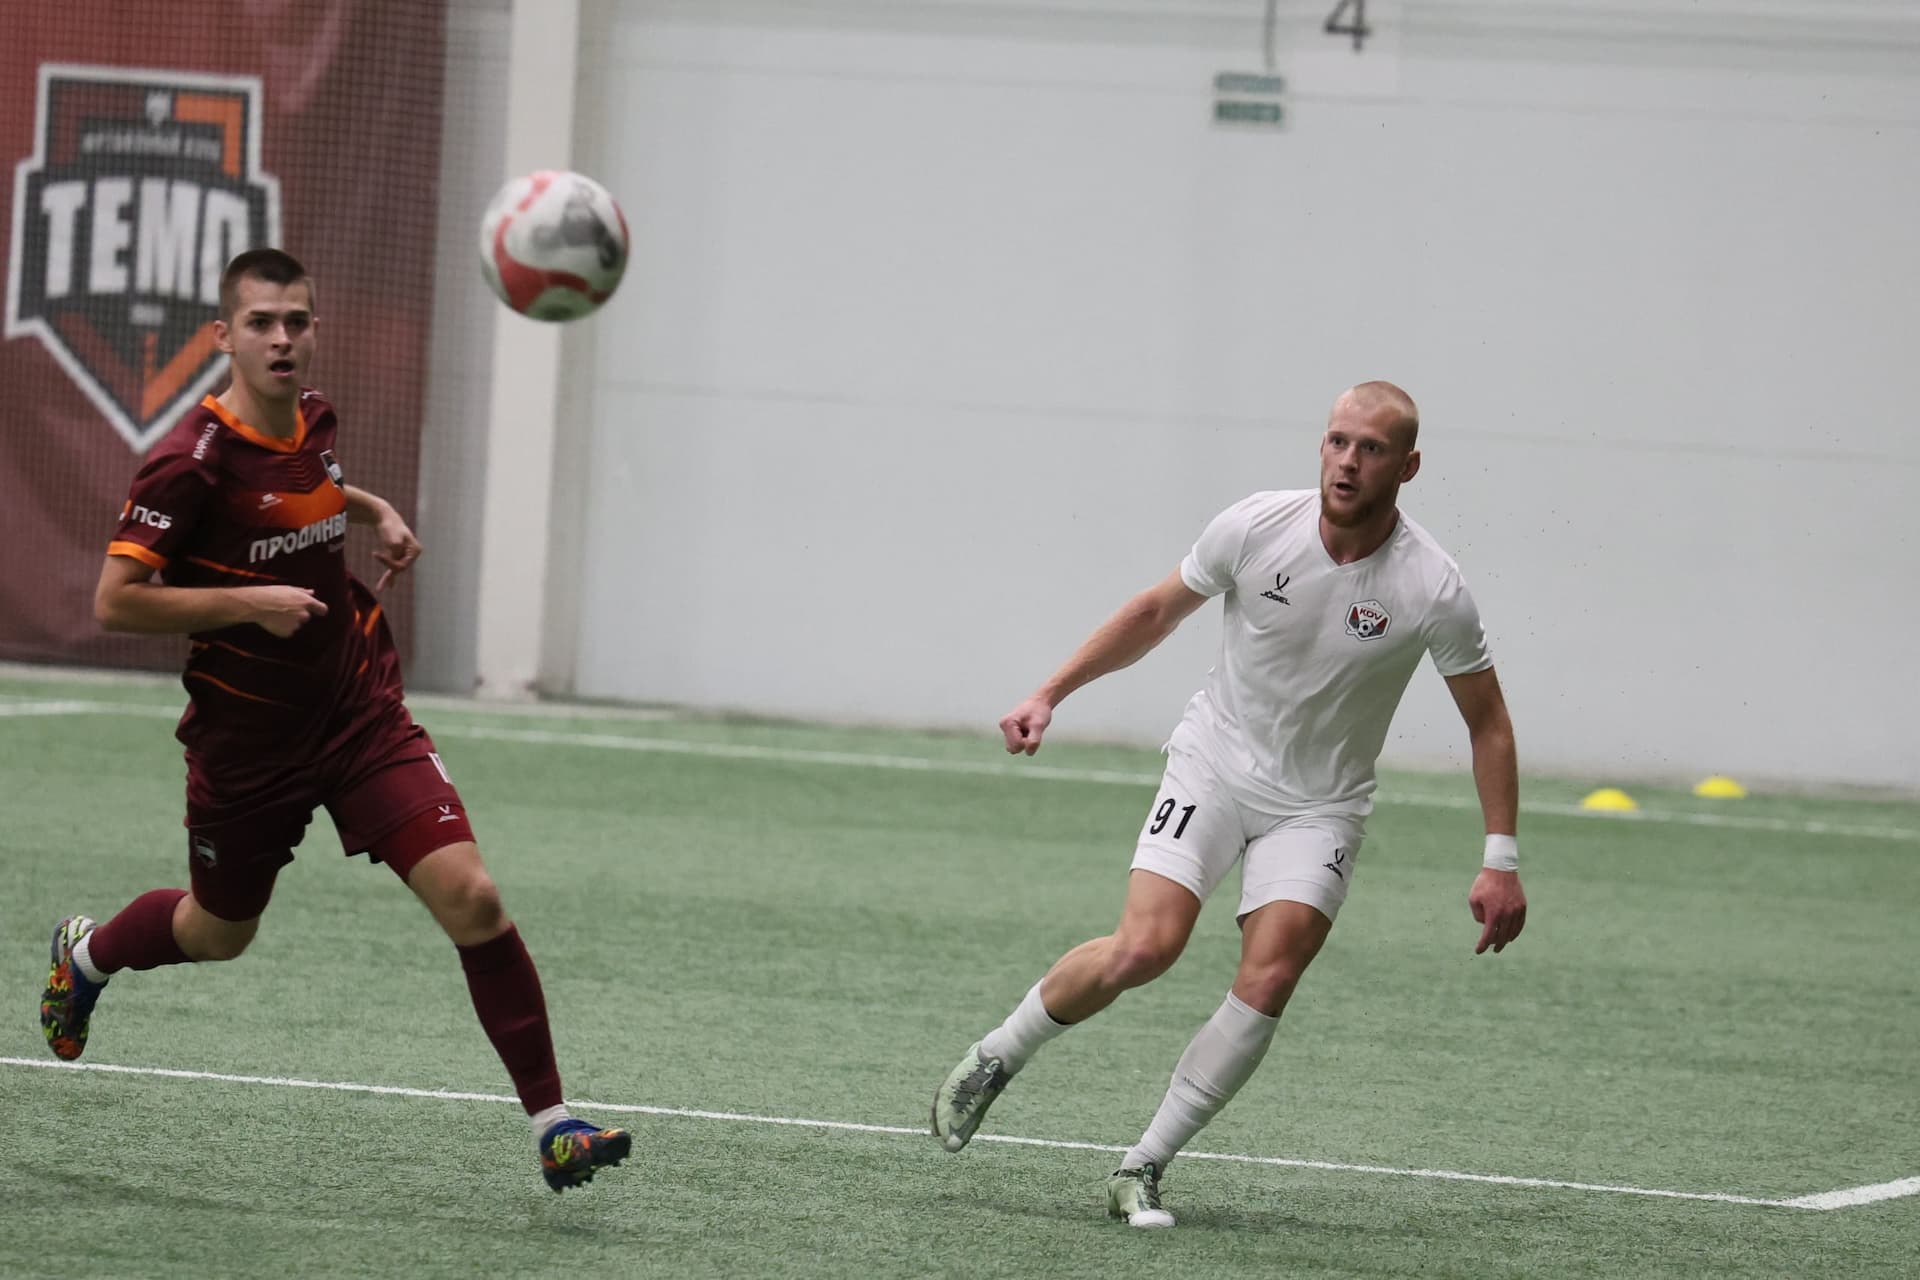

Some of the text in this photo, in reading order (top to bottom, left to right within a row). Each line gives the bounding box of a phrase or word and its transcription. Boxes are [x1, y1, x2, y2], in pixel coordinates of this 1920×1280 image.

[1324, 0, 1373, 54] 4
[41, 176, 249, 305] ТЕМП
[131, 504, 172, 530] ПСБ
[249, 511, 347, 563] ПРОДИНВ
[1150, 798, 1196, 839] 91
